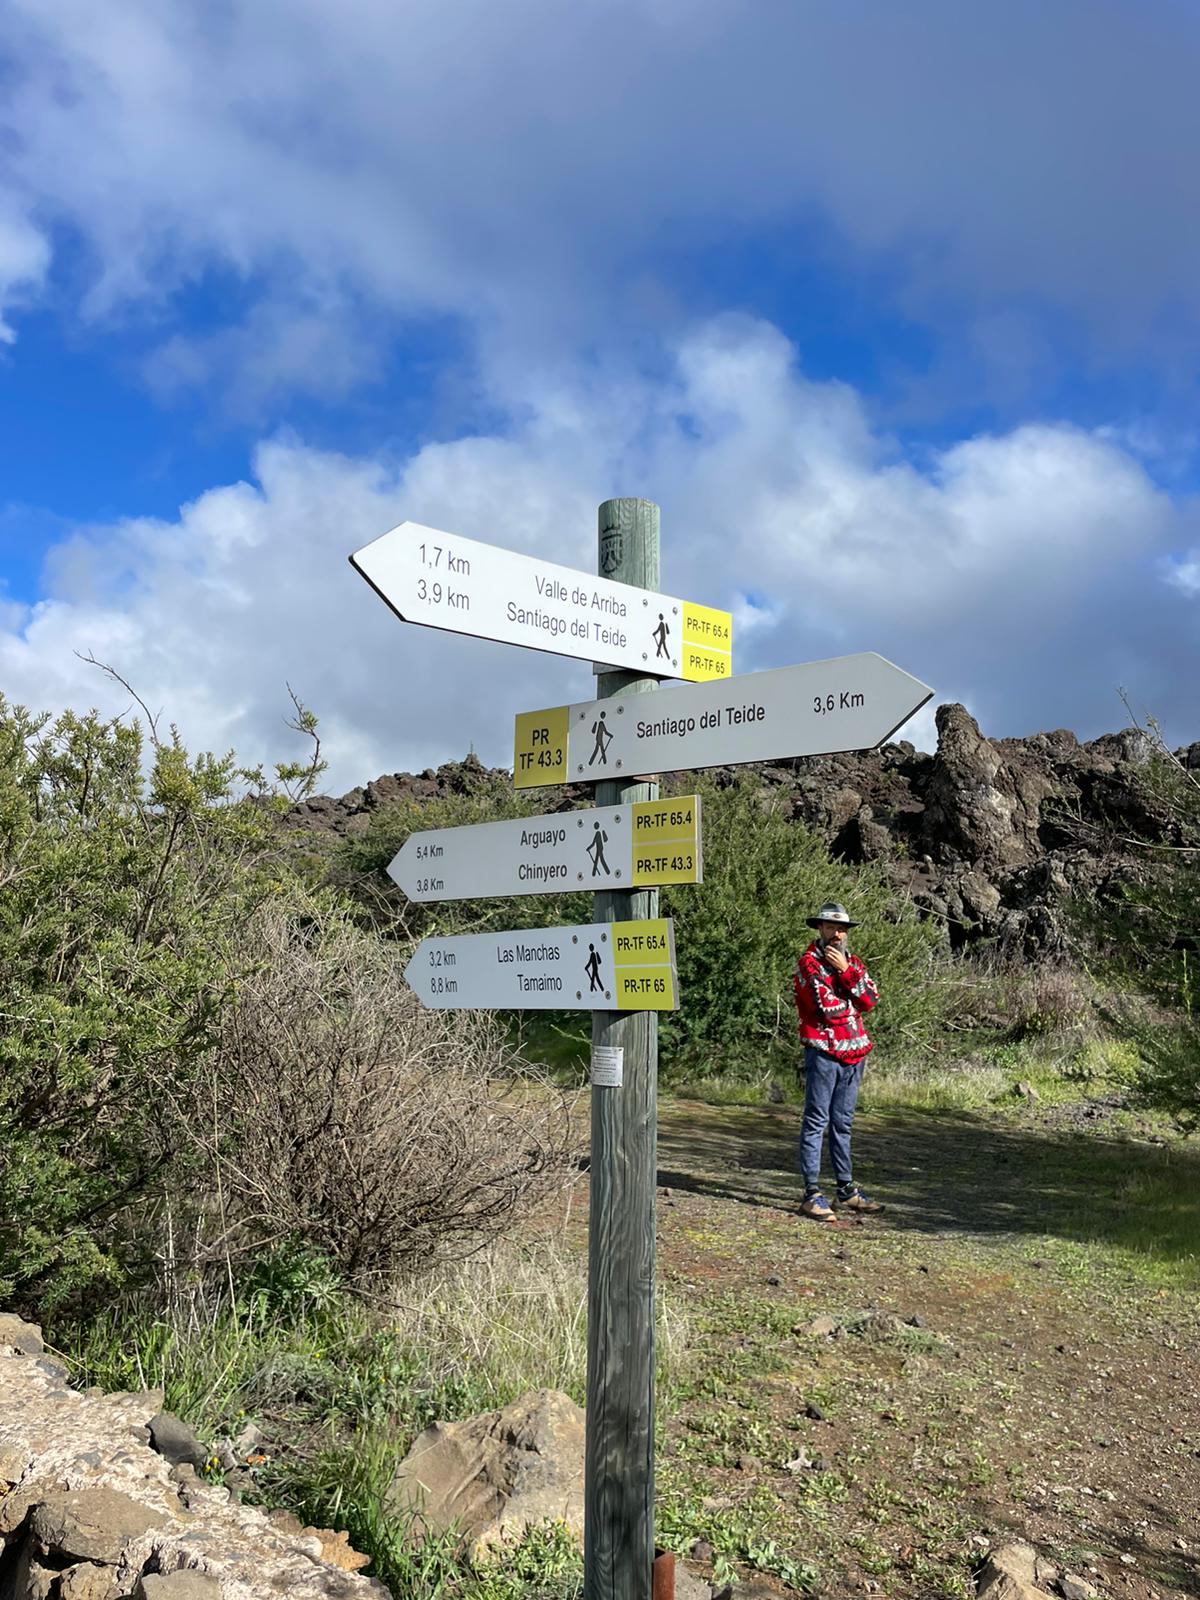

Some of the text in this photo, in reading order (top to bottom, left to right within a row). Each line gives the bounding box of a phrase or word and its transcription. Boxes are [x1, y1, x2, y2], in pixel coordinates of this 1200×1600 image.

[419, 544, 470, 575] 1,7 km
[418, 579, 470, 610] 3,9 km
[536, 575, 626, 617] Valle de Arriba
[507, 602, 626, 647] Santiago del Teide
[687, 617, 728, 639] PR-TF 65.4
[690, 655, 725, 674] PR-TF 65
[814, 692, 864, 715] 3,6 Km
[637, 704, 765, 739] Santiago del Teide
[532, 728, 549, 746] PR
[520, 749, 563, 770] TF 43.3
[637, 811, 692, 829] PR-TF 65.4
[521, 828, 565, 849] Arguayo
[417, 845, 443, 859] 5,4 Km
[519, 864, 567, 882] Chinyero
[637, 856, 692, 872] PR-TF 43.3
[417, 878, 444, 893] 3,8 Km
[617, 935, 665, 950] PR-TF 65.4
[429, 950, 456, 967] 3,2 km
[498, 943, 560, 963] Las Manchas
[431, 978, 457, 993] 8,8 km
[517, 974, 562, 991] Tamaimo
[624, 979, 665, 993] PR-TF 65
